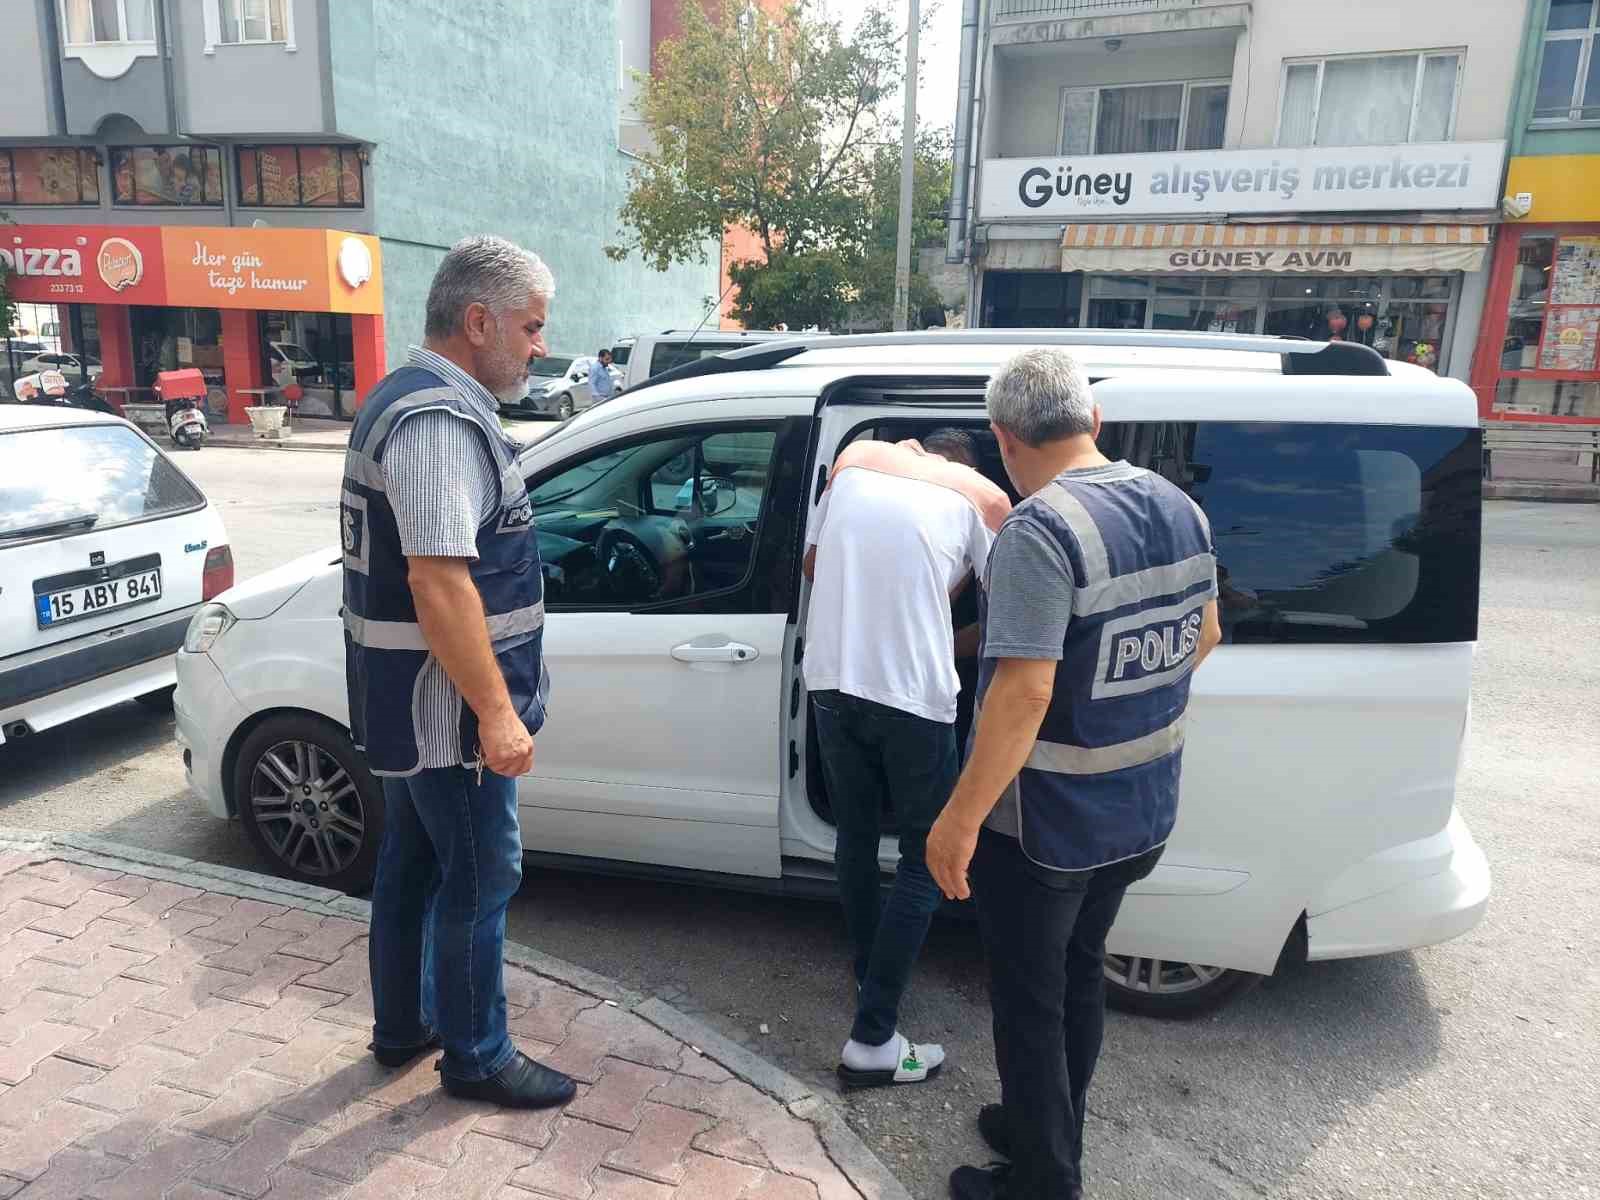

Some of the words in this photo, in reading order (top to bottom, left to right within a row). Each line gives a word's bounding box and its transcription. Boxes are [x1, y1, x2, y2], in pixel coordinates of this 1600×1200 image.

[1019, 166, 1132, 208] Güney
[1150, 160, 1300, 201] alışveriş
[1313, 153, 1472, 191] merkezi
[192, 240, 226, 266] Her
[232, 251, 263, 273] gün
[1169, 249, 1274, 267] GÜNEY
[1282, 251, 1352, 267] AVM
[208, 269, 246, 295] taze
[251, 271, 308, 291] hamur
[52, 593, 74, 618] 15
[83, 582, 119, 611] ABY
[127, 573, 159, 599] 841
